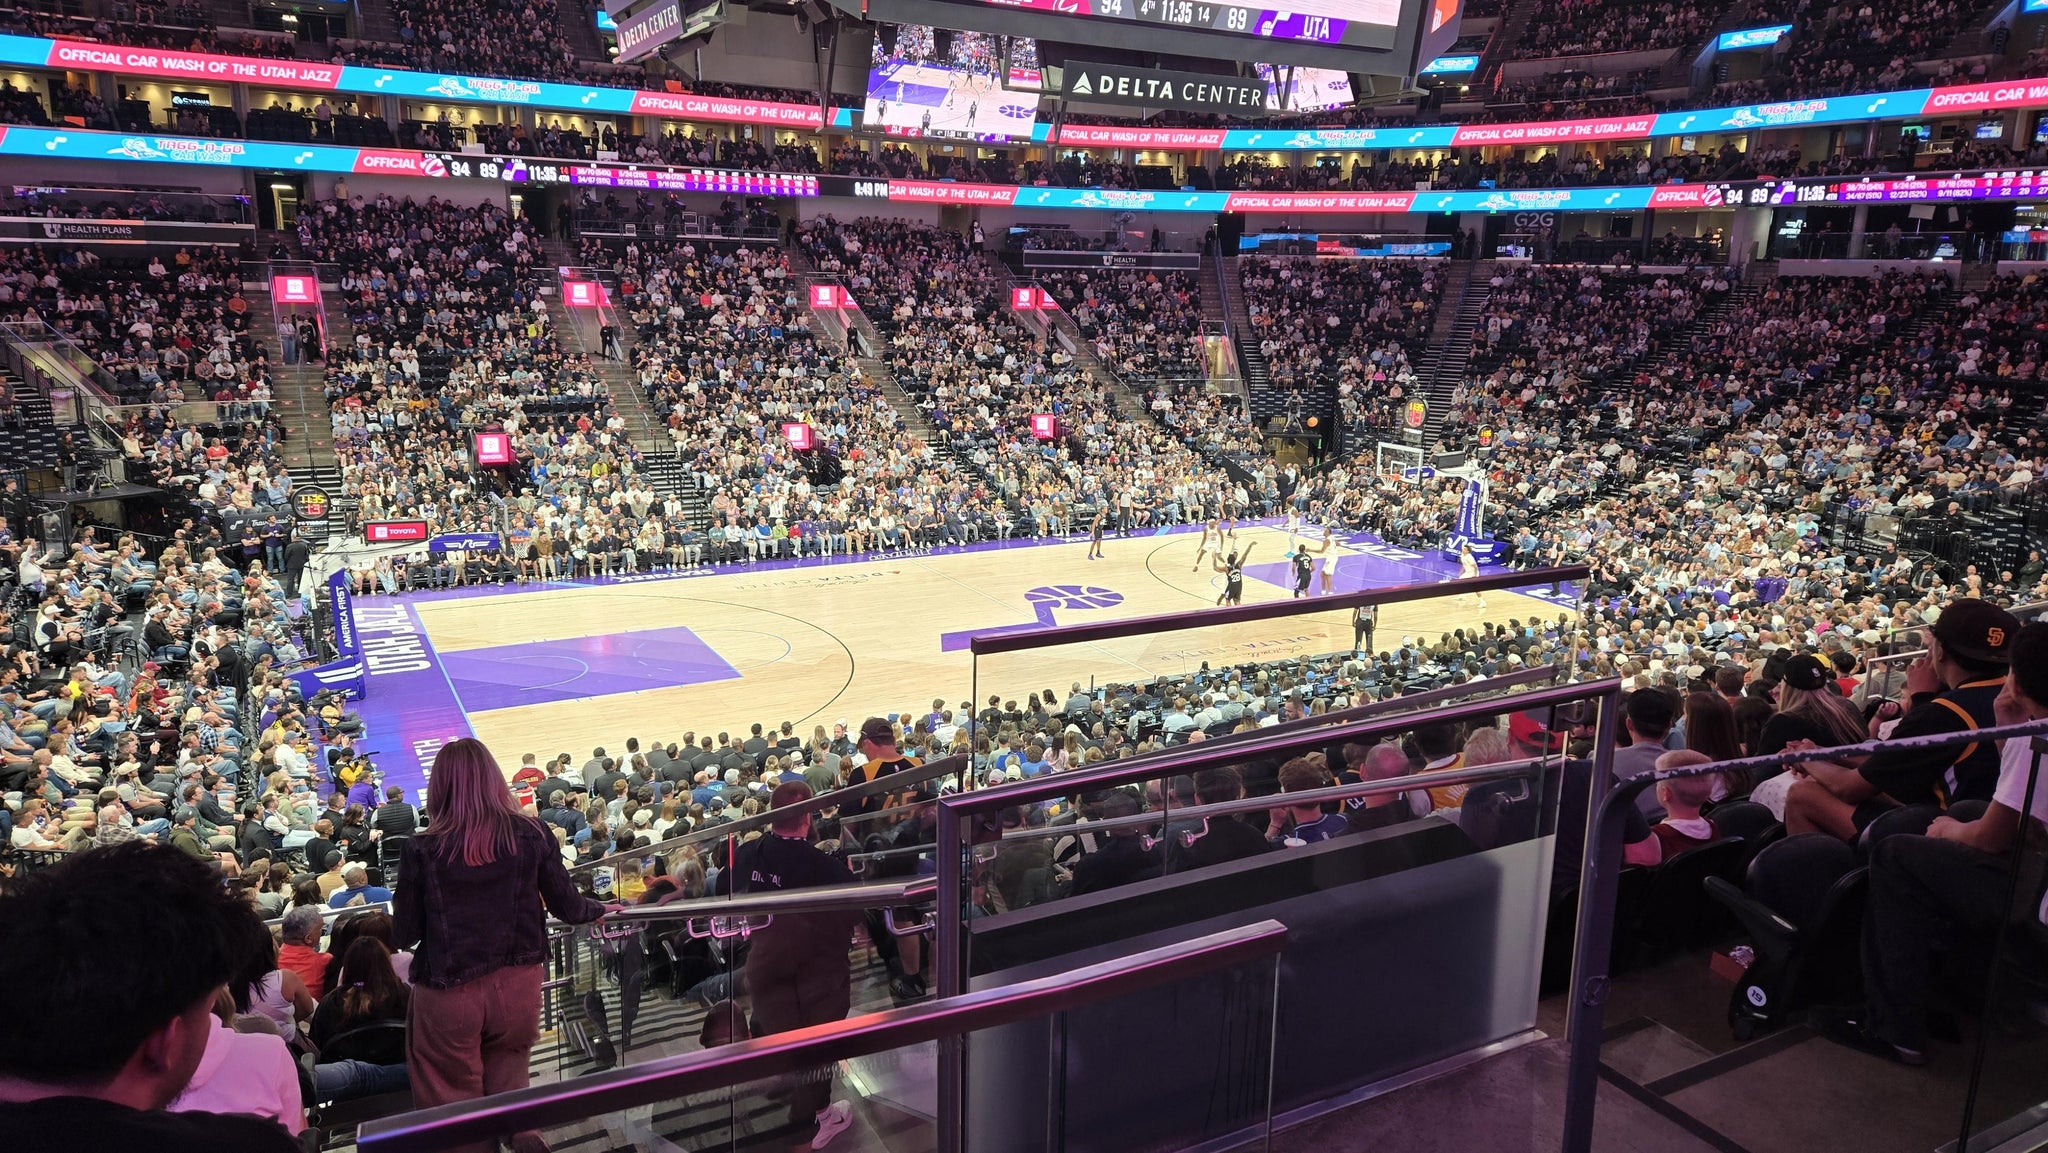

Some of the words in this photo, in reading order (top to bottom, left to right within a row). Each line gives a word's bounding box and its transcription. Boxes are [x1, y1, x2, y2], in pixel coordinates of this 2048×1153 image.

[624, 21, 650, 49] DELTA
[648, 4, 679, 35] CENTER
[1161, 0, 1193, 23] 11:35
[1198, 6, 1210, 22] 14
[1227, 8, 1248, 30] 89
[1303, 15, 1330, 40] UTA
[59, 48, 124, 66] OFFICIAL
[126, 54, 159, 68] CAR
[161, 57, 206, 72] WASH
[208, 61, 228, 73] OF
[231, 63, 258, 76] THE
[260, 66, 297, 79] UTAH
[299, 70, 332, 82] JAZZ
[1099, 75, 1174, 100] DELTA
[1182, 82, 1262, 107] CENTER
[1933, 91, 1990, 106] OFFICIAL
[1994, 87, 2026, 102] CAR
[639, 97, 684, 112] OFFICIAL
[686, 101, 708, 113] CAR
[711, 104, 741, 117] WASH
[744, 106, 758, 117] OF
[760, 108, 779, 119] THE
[780, 110, 805, 122] UTAH
[1060, 129, 1089, 140] FFICIAL
[1091, 131, 1110, 141] CAR
[1112, 132, 1138, 142] WASH
[1139, 133, 1154, 143] OF
[1154, 133, 1172, 143] THE
[1173, 134, 1196, 144] UTAH
[1196, 134, 1219, 144] JAZZ
[1459, 129, 1500, 141] OFFICIAL
[1502, 127, 1523, 138] CAR
[1526, 125, 1556, 137] WASH
[1557, 124, 1573, 135] OF
[1574, 123, 1596, 134] THE
[1595, 122, 1621, 134] UTAH
[1621, 120, 1649, 132] JAZZ
[170, 150, 195, 161] CAR
[196, 151, 231, 163] WASH
[363, 156, 417, 169] OFFICIAL
[451, 161, 472, 177] 94
[480, 163, 499, 178] 89
[529, 165, 557, 181] 11:35
[855, 182, 873, 197] 8:49
[874, 183, 889, 197] PM
[889, 185, 906, 195] CAR
[908, 187, 935, 198] WASH
[936, 188, 951, 198] OF
[951, 188, 966, 199] THE
[967, 190, 989, 200] UTAH
[989, 191, 1011, 201] JAZZ
[1656, 191, 1699, 202] OFFICIAL
[1726, 189, 1743, 204] 94
[1751, 187, 1769, 203] 89
[1797, 185, 1826, 202] 11:35
[1985, 187, 1992, 196] 7
[2000, 187, 2011, 196] 22
[1231, 197, 1270, 207] OFFICIAL
[1271, 198, 1292, 207] CAR
[1294, 198, 1322, 207] WASH
[1323, 198, 1337, 207] OF
[1338, 198, 1357, 207] THE
[1357, 198, 1383, 207] UTAH
[1383, 197, 1409, 207] JAZZ
[1514, 212, 1554, 227] G2G
[63, 225, 100, 234] HEALTH
[101, 226, 133, 234] PLANS
[1303, 559, 1310, 569] 5
[1231, 573, 1241, 583] 28
[335, 585, 348, 611] FIRST
[339, 609, 354, 648] AMERICA
[352, 603, 415, 635] JAZZ
[361, 634, 432, 676] UTAH
